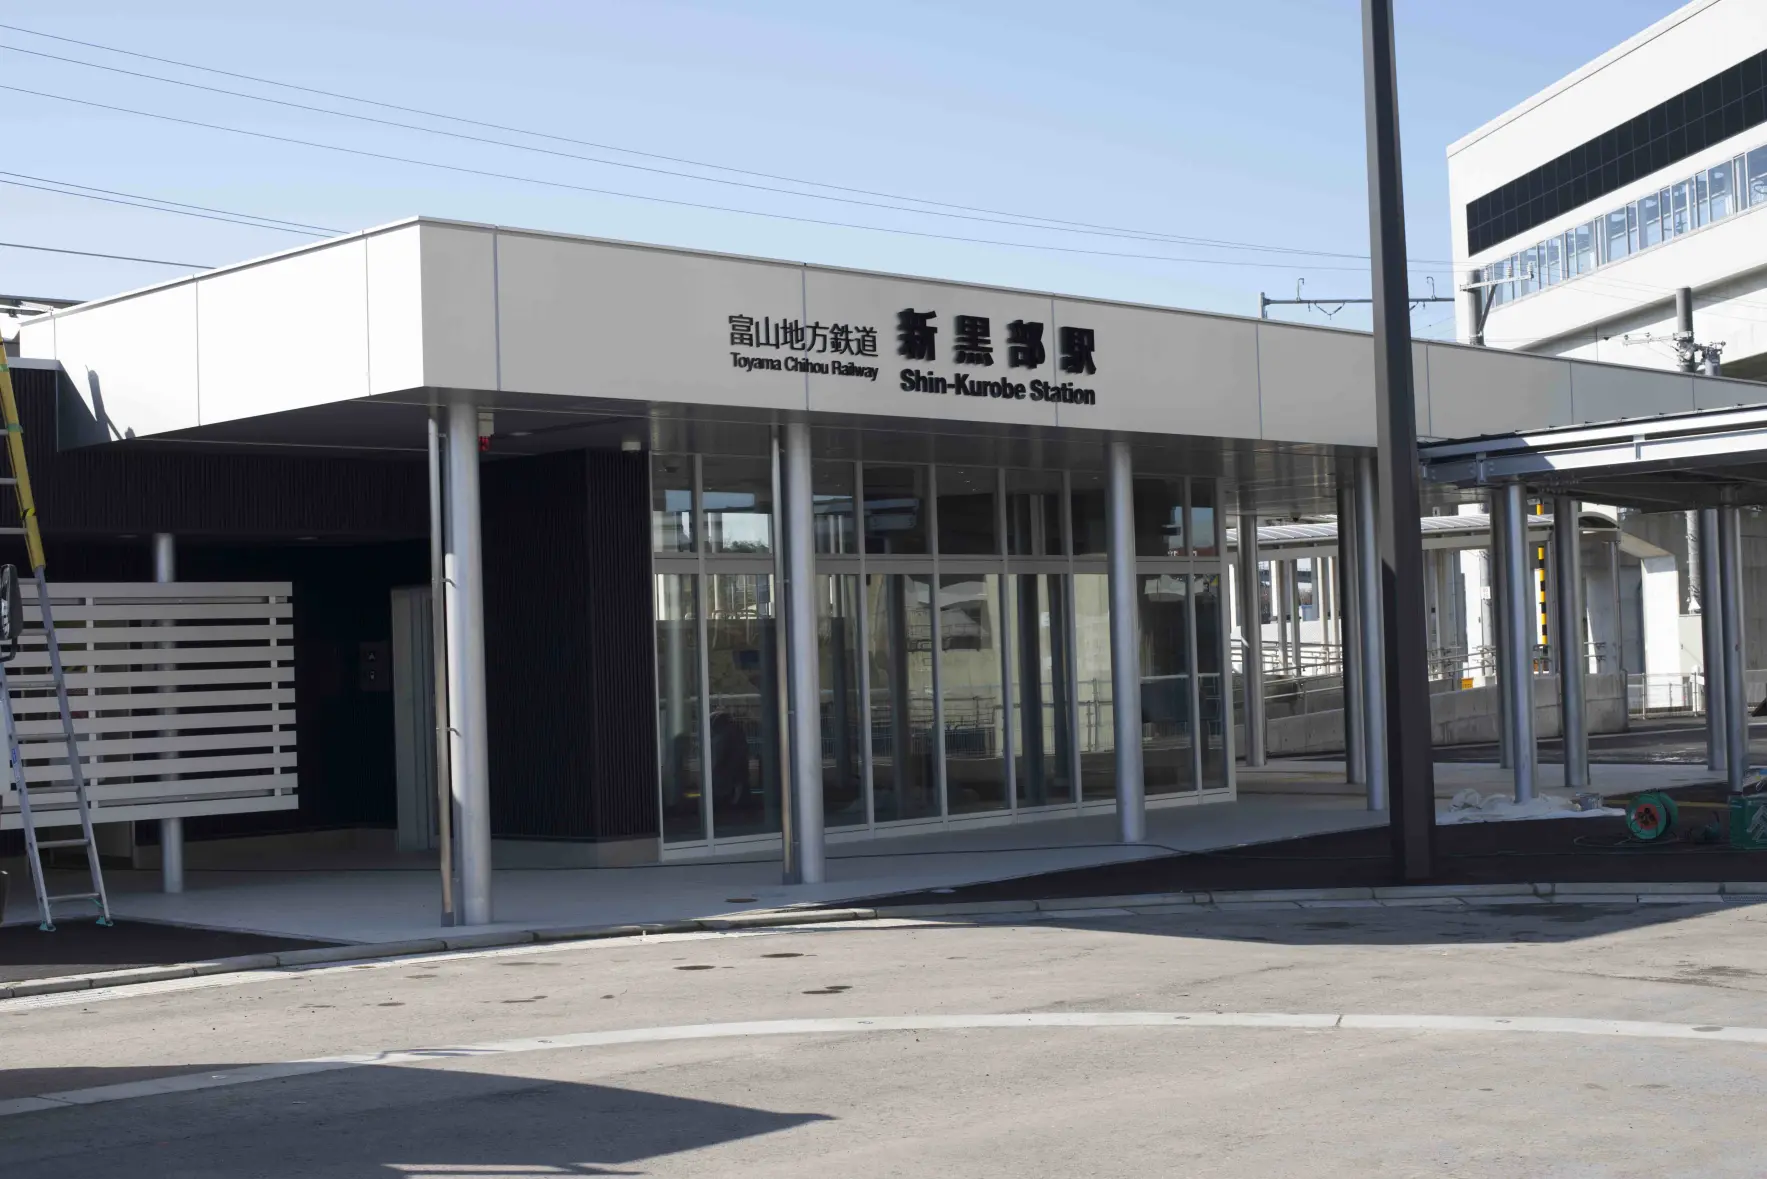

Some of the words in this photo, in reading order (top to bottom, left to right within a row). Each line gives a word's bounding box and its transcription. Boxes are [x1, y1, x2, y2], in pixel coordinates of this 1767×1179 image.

[728, 313, 879, 358] 富山地方鉄道
[896, 308, 1097, 375] 新黒部駅
[730, 352, 782, 373] Toyama
[784, 356, 829, 376] Chihou
[831, 360, 879, 382] Railway
[900, 369, 1026, 400] Shin-Kurobe
[1029, 378, 1096, 406] Station
